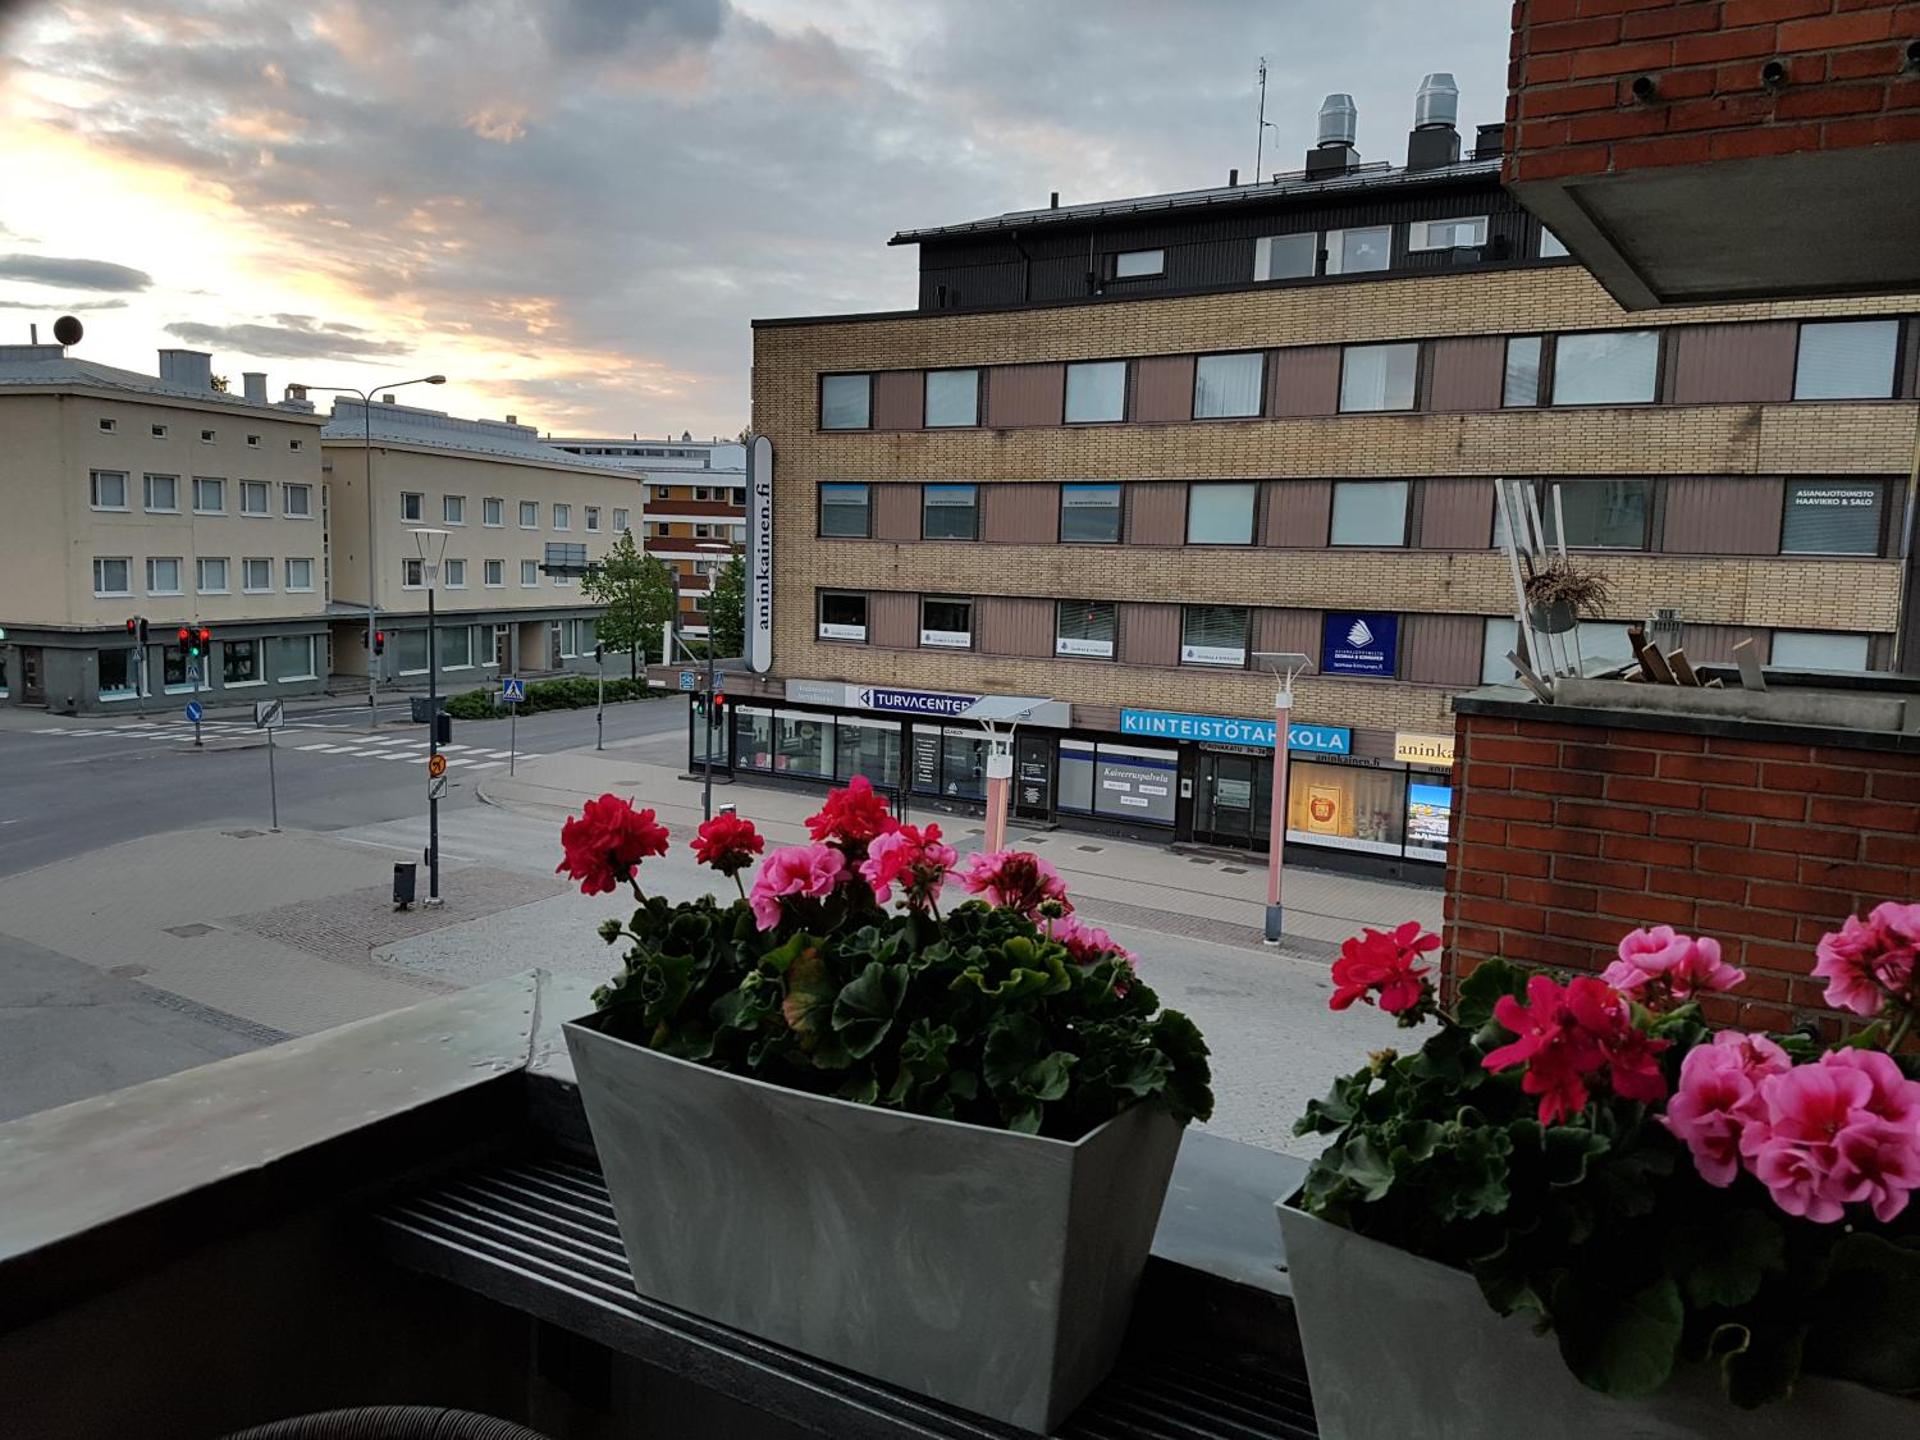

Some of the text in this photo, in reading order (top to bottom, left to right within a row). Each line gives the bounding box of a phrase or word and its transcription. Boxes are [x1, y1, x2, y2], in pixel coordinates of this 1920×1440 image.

[1796, 489, 1875, 498] ASIANAJOTOIMISTO
[1841, 498, 1848, 506] &
[1850, 498, 1873, 506] SALO
[755, 482, 770, 631] aninkainen.fi
